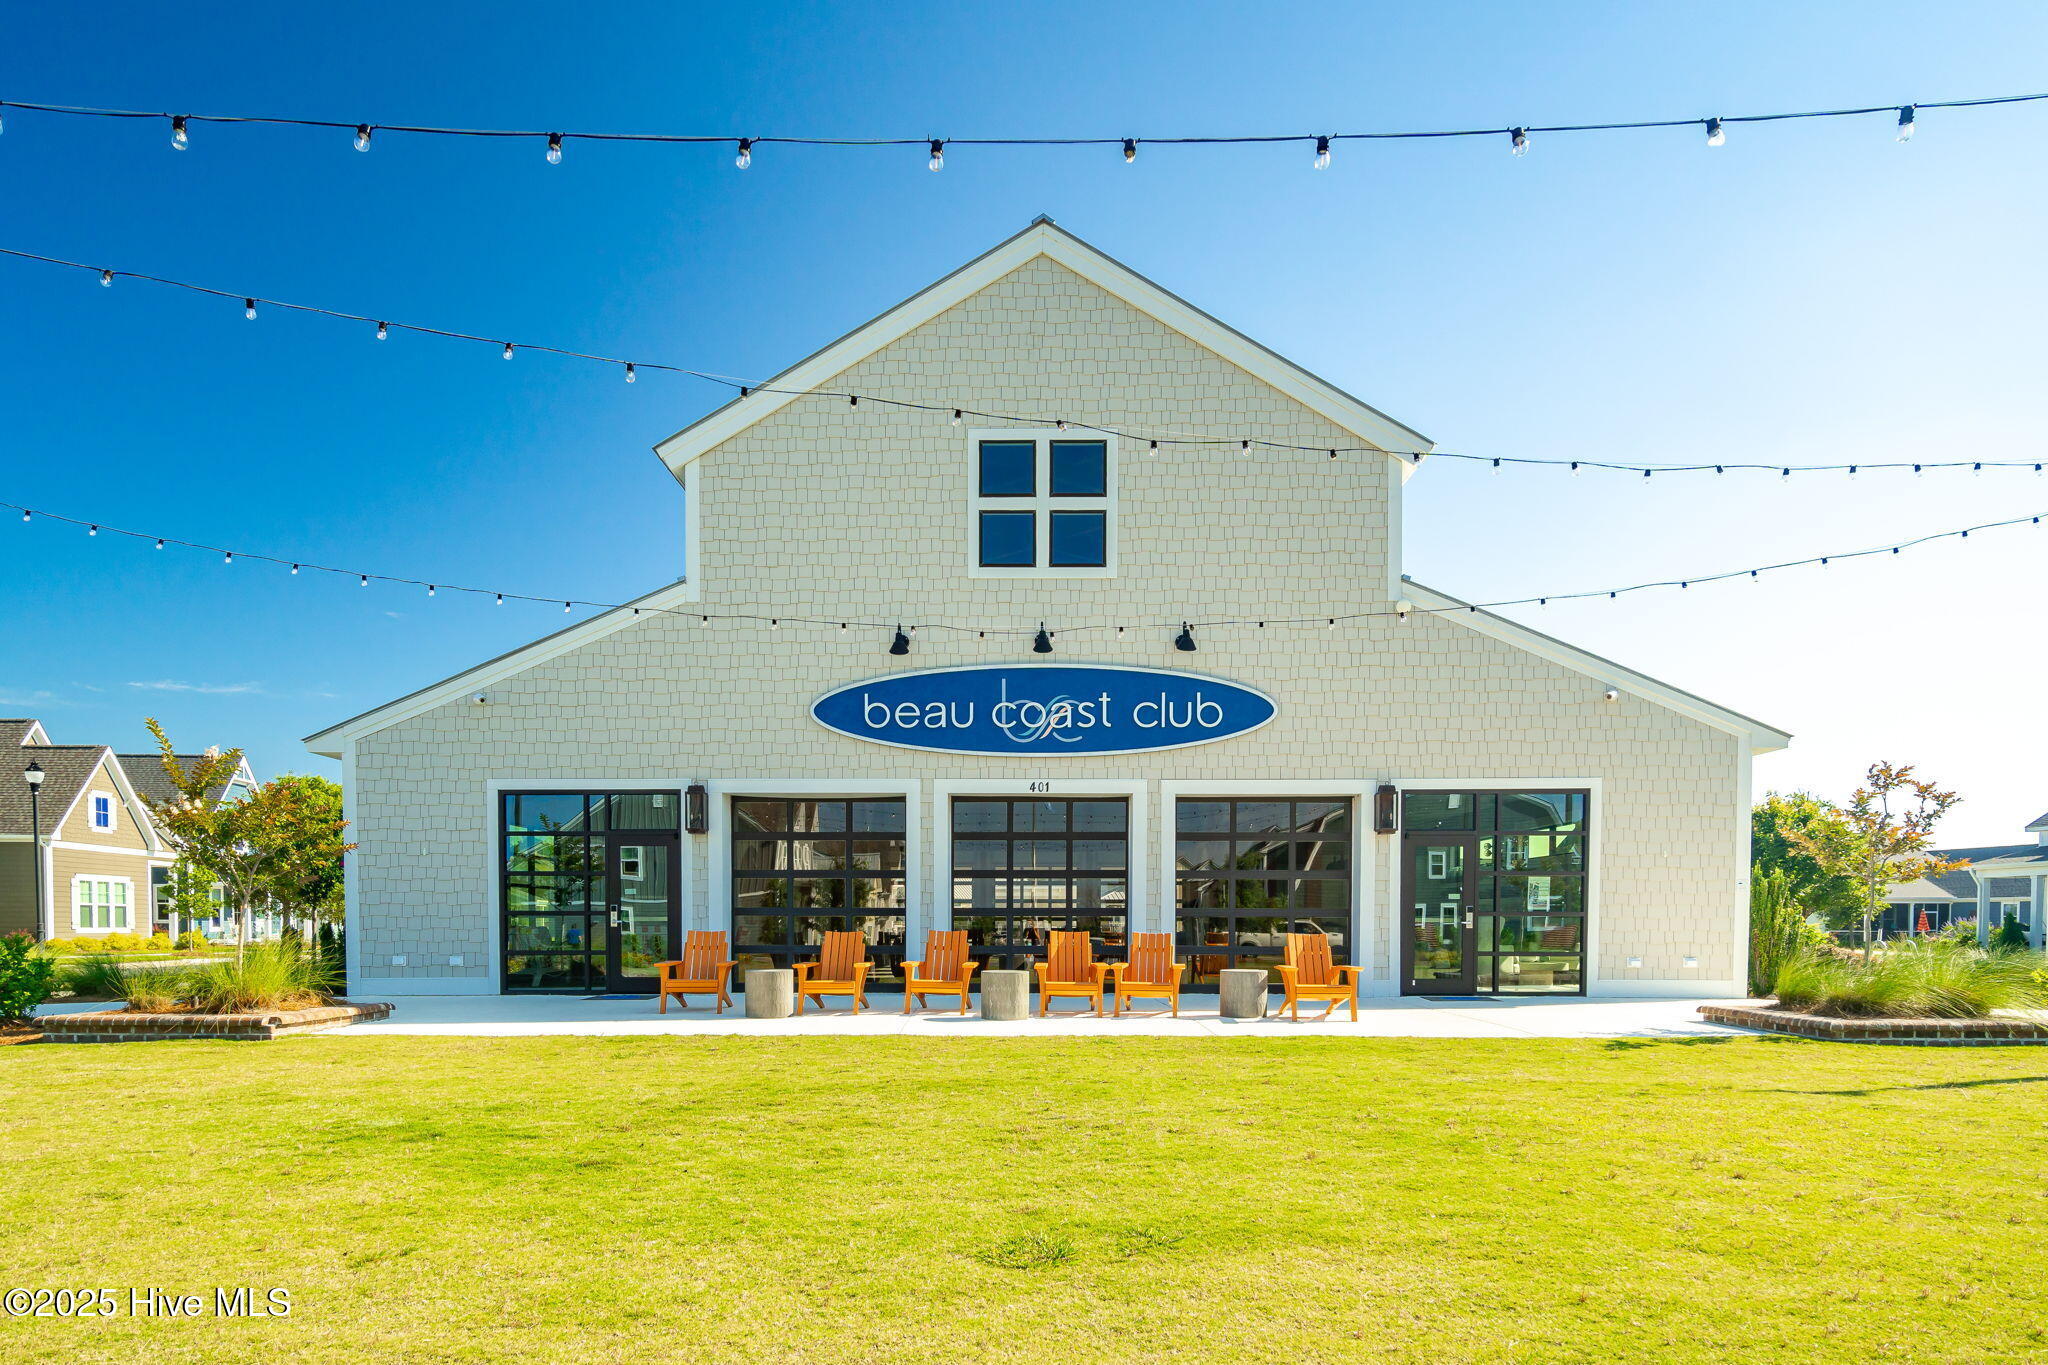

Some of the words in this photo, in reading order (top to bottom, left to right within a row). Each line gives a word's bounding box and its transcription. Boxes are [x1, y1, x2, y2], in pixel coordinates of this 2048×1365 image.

[864, 692, 974, 729] beau
[991, 691, 1112, 729] coast
[1132, 691, 1224, 729] club
[1029, 781, 1049, 793] 401
